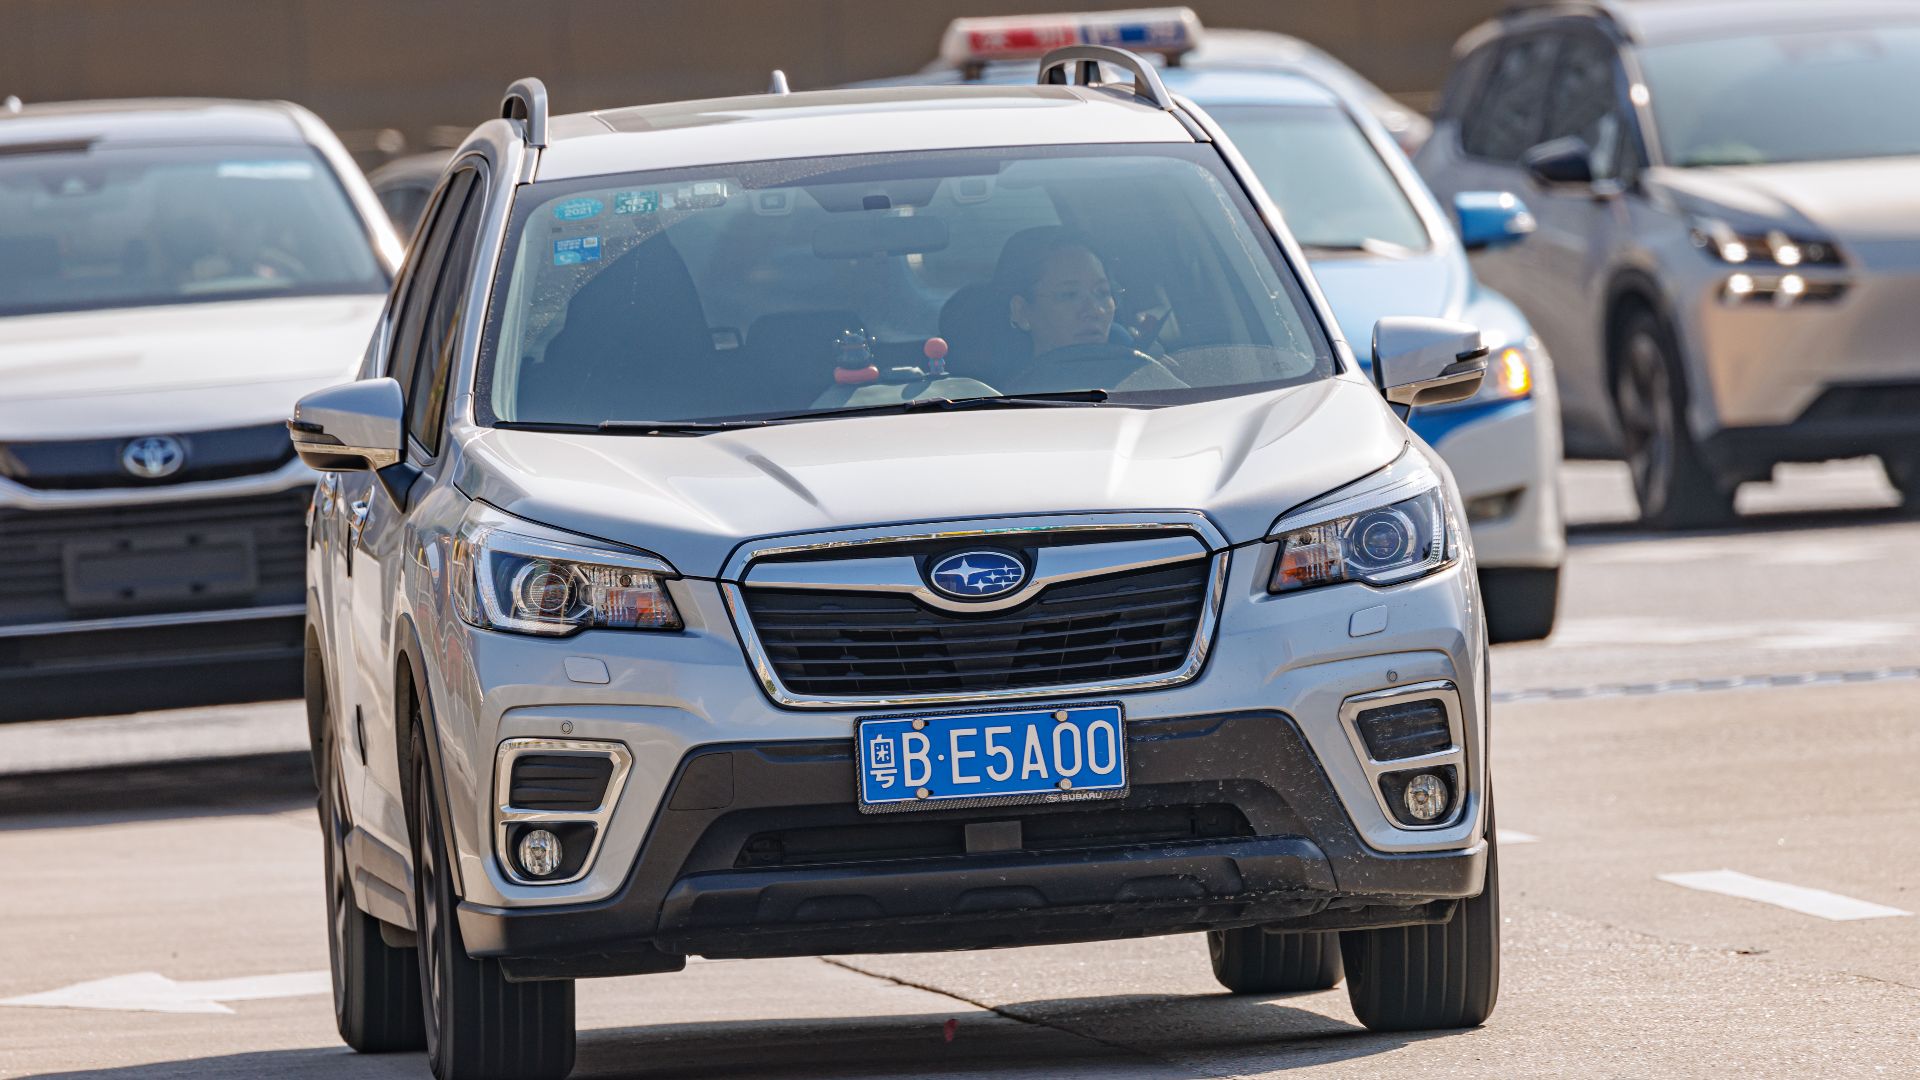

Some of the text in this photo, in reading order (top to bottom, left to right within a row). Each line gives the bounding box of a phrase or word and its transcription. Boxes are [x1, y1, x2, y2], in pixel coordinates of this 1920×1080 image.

[564, 206, 592, 217] 2021
[615, 203, 653, 214] 2021
[1061, 792, 1103, 801] SUBARU
